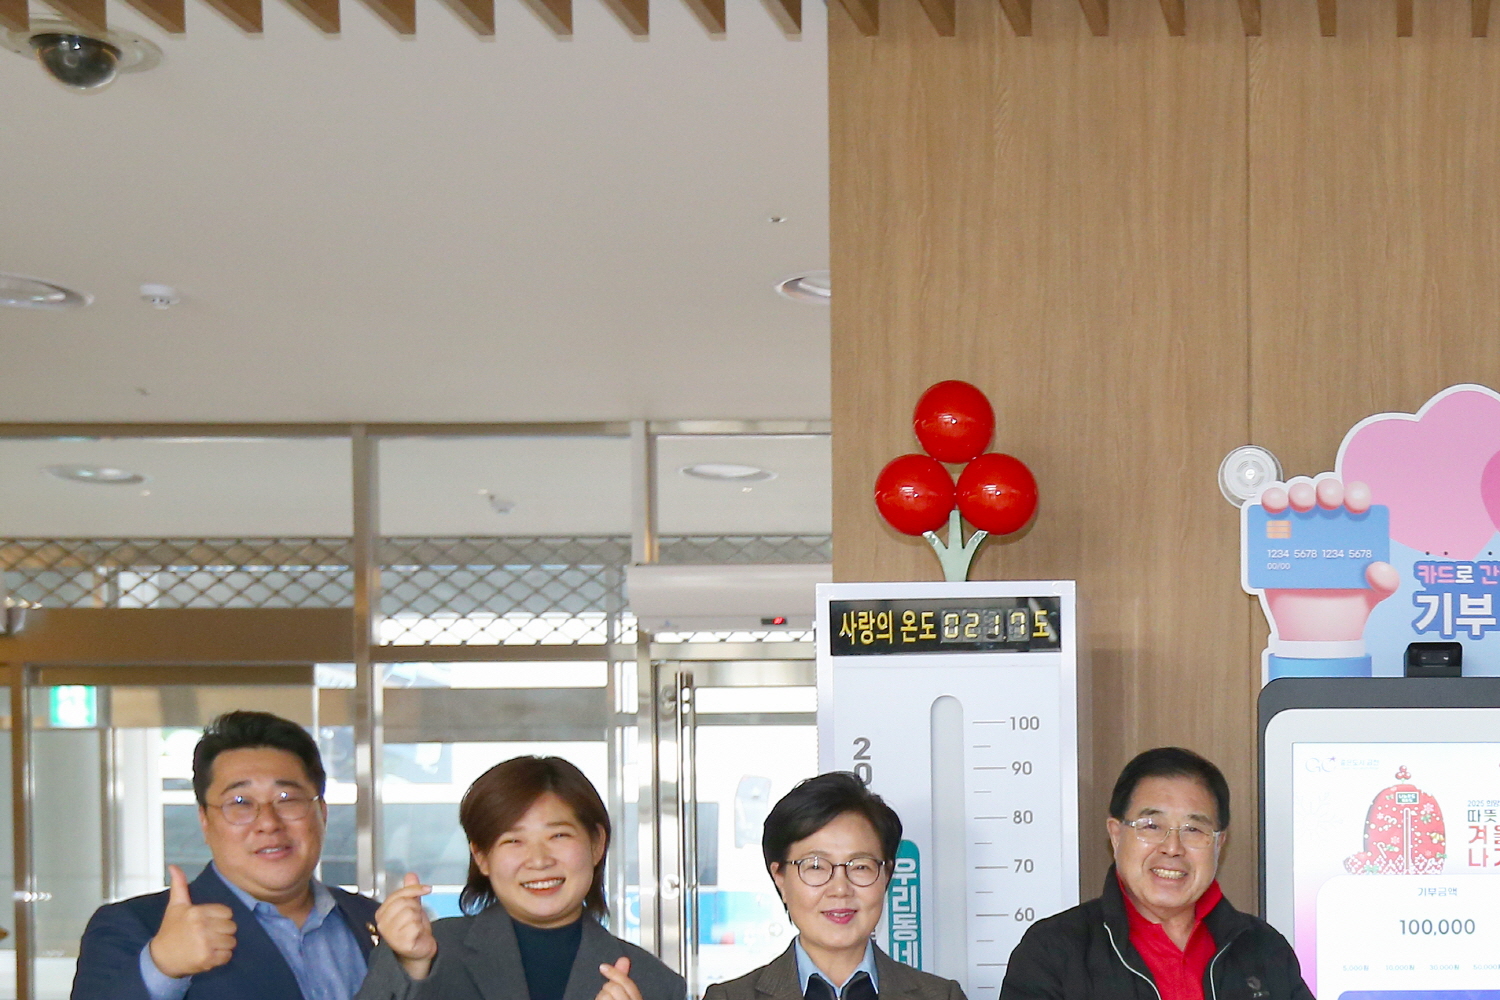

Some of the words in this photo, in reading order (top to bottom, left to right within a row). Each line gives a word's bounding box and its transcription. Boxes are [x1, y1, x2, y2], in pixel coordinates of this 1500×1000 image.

[1267, 549, 1289, 558] 1234
[1294, 549, 1317, 558] 5678
[1322, 549, 1344, 558] 1234
[1348, 549, 1372, 558] 5678
[1267, 562, 1290, 571] 00/00
[1418, 564, 1474, 584] 카드로
[1414, 593, 1496, 637] 기부
[838, 609, 894, 645] 사랑의
[900, 609, 937, 643] 온도
[1032, 609, 1050, 639] 도
[1010, 716, 1040, 731] 100
[1011, 761, 1033, 776] 90
[1467, 800, 1485, 808] 2025
[1013, 810, 1034, 824] 80
[1014, 859, 1035, 873] 70
[1417, 887, 1458, 897] 기부금액
[1014, 908, 1035, 922] 60
[1399, 918, 1476, 937] 100,000
